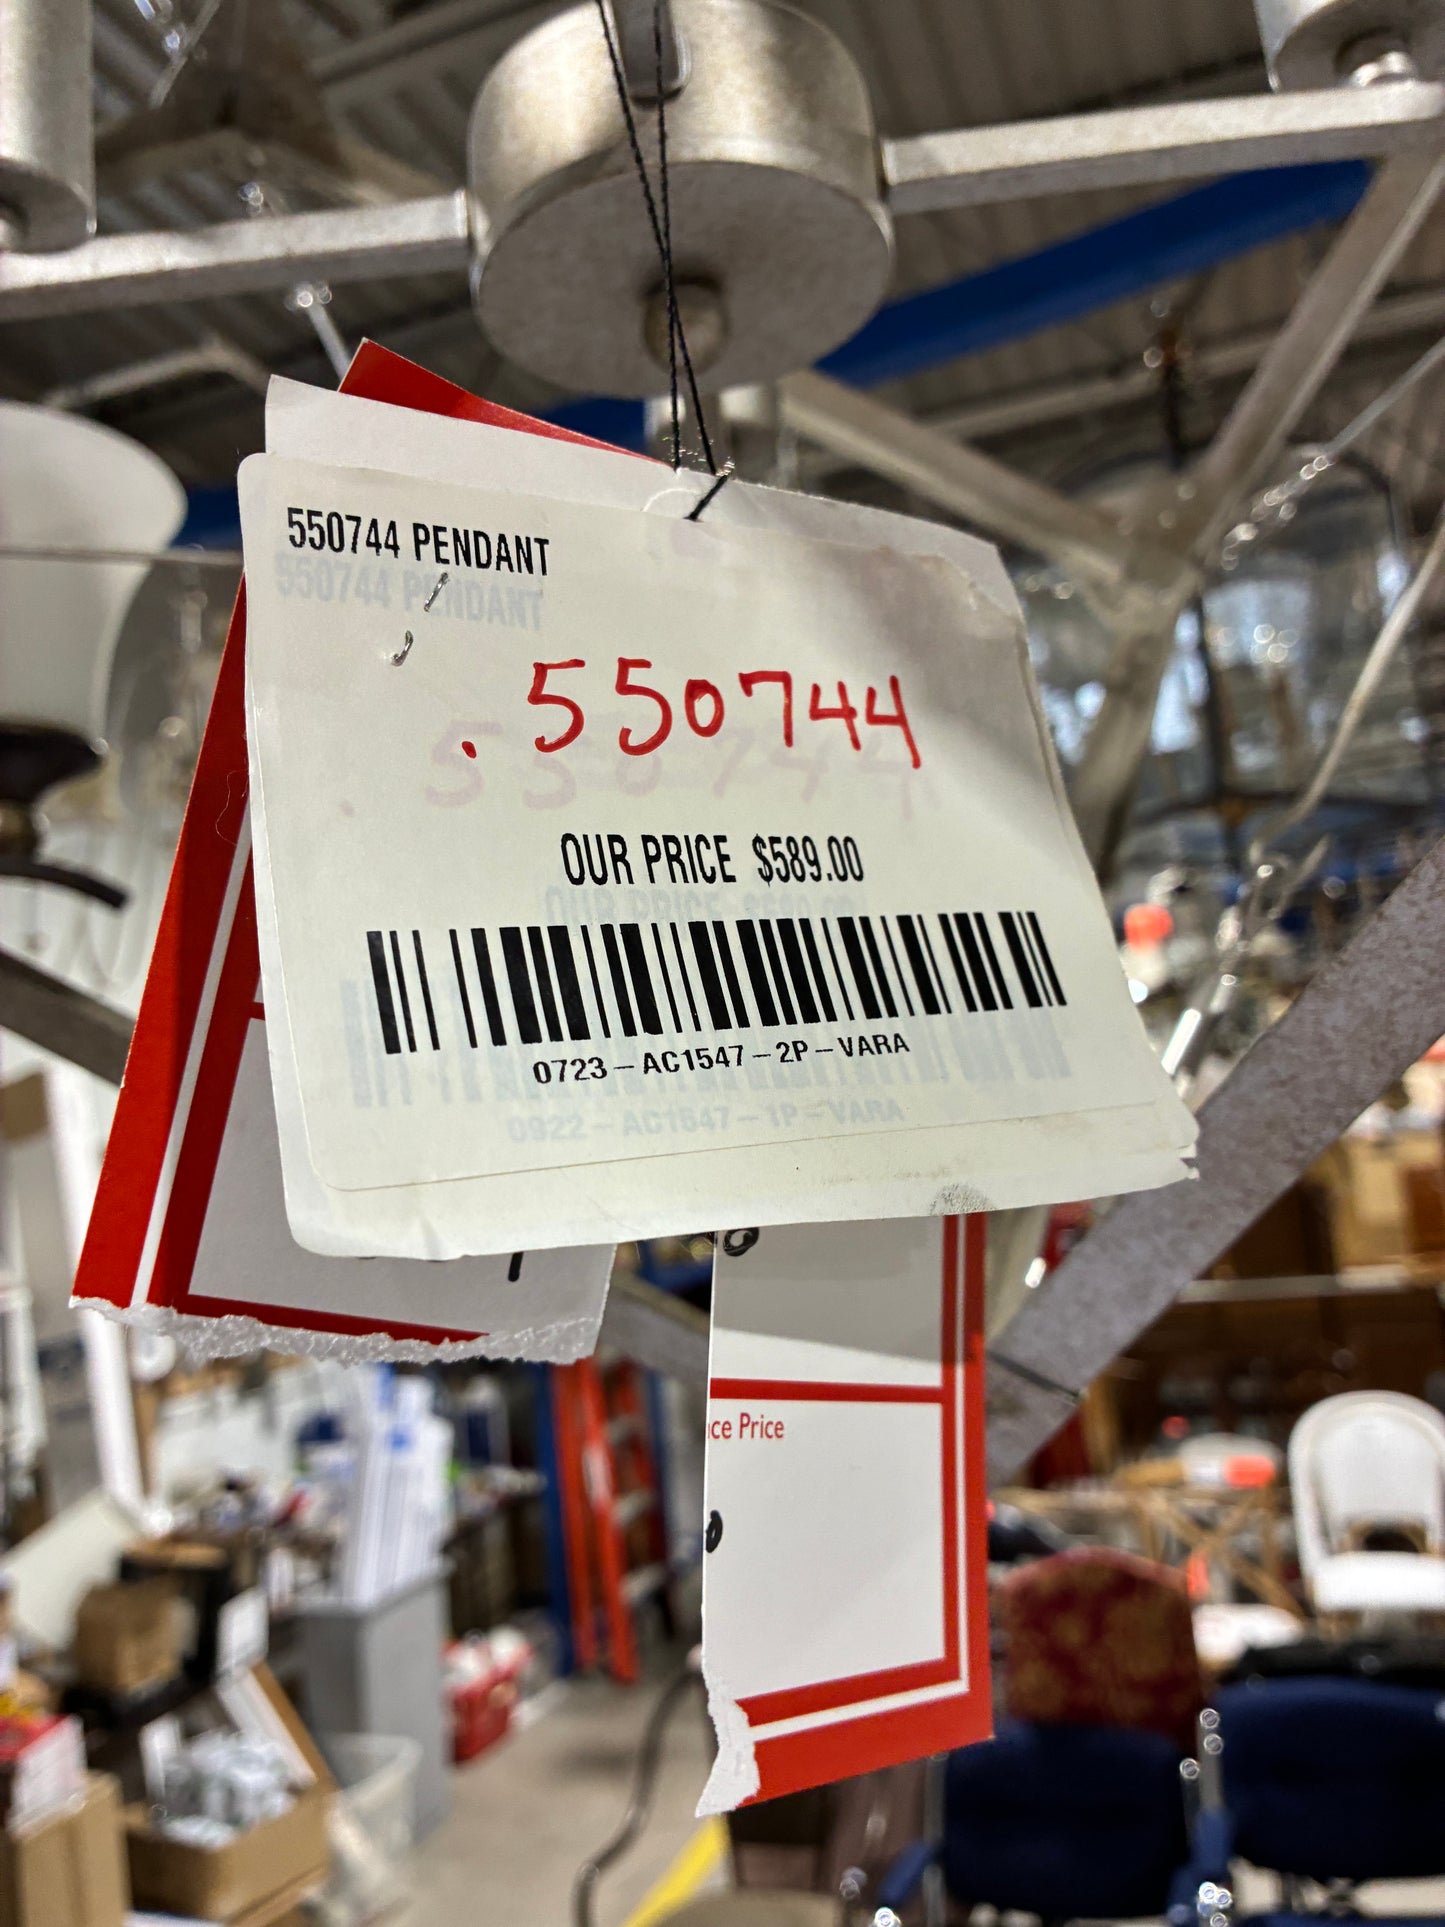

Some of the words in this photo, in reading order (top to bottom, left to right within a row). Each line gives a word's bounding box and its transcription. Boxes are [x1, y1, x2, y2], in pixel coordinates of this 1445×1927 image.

[287, 507, 400, 559] 550744
[413, 522, 550, 577] PENDANT
[561, 833, 634, 885] OUR
[641, 833, 737, 885] PRICE
[752, 834, 865, 887] $589.00
[739, 1411, 785, 1440] Price
